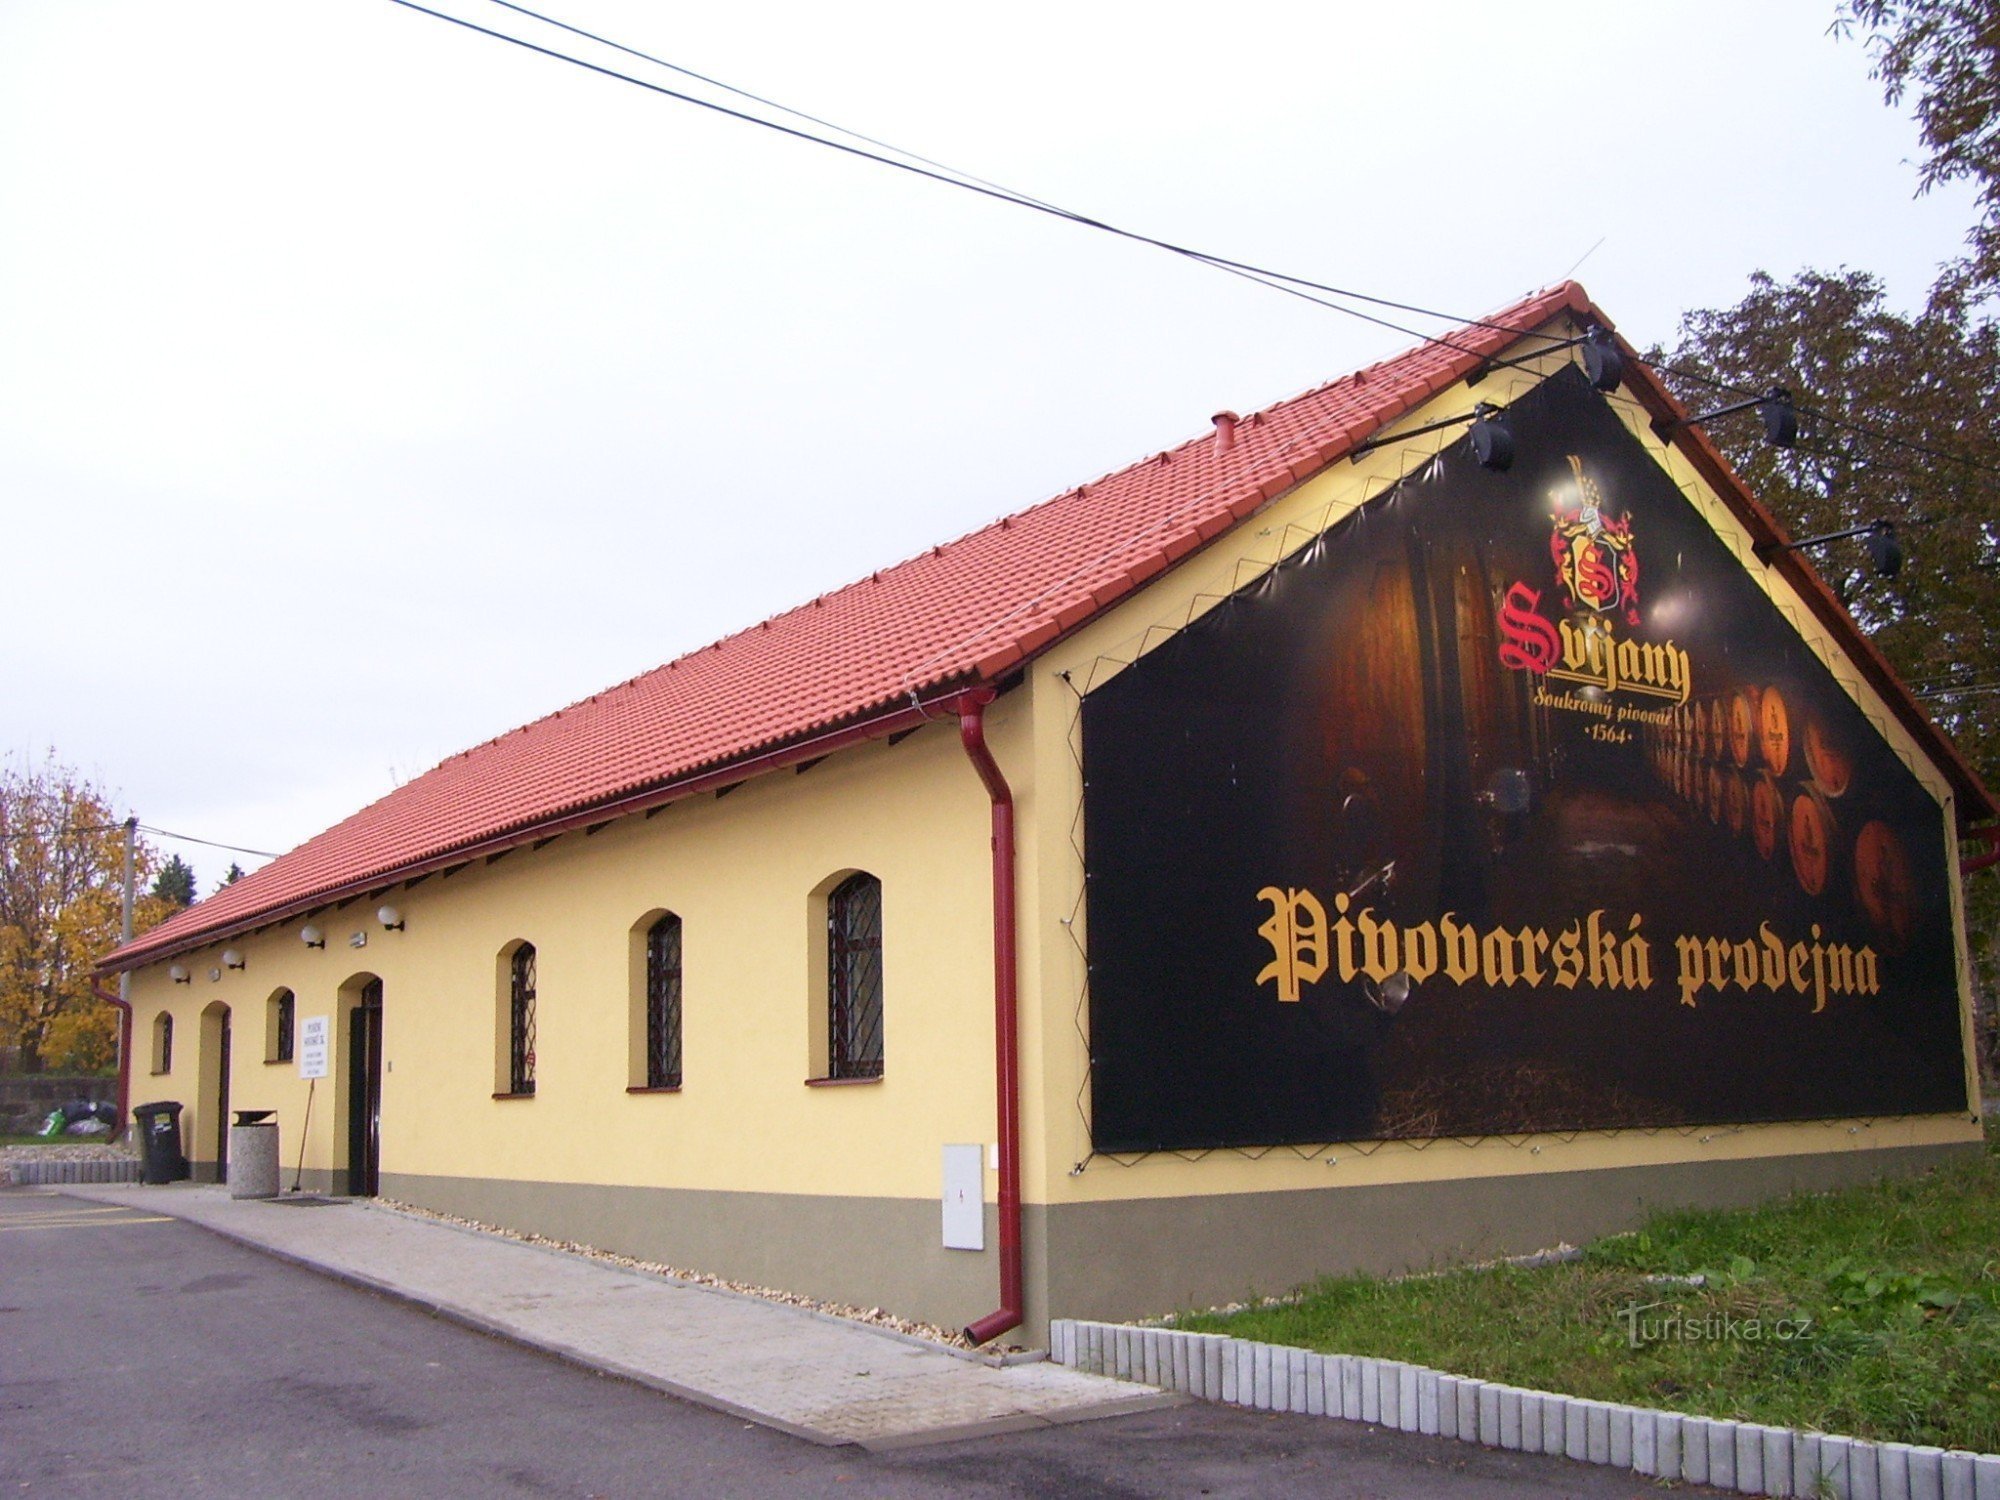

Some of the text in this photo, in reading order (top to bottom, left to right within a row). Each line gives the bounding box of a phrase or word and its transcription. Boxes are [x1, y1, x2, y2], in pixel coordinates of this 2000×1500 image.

[1498, 580, 1691, 706] Svijany
[1533, 685, 1673, 727] Soukromý pivovar
[1255, 886, 1882, 1013] Pivovarská prodejna
